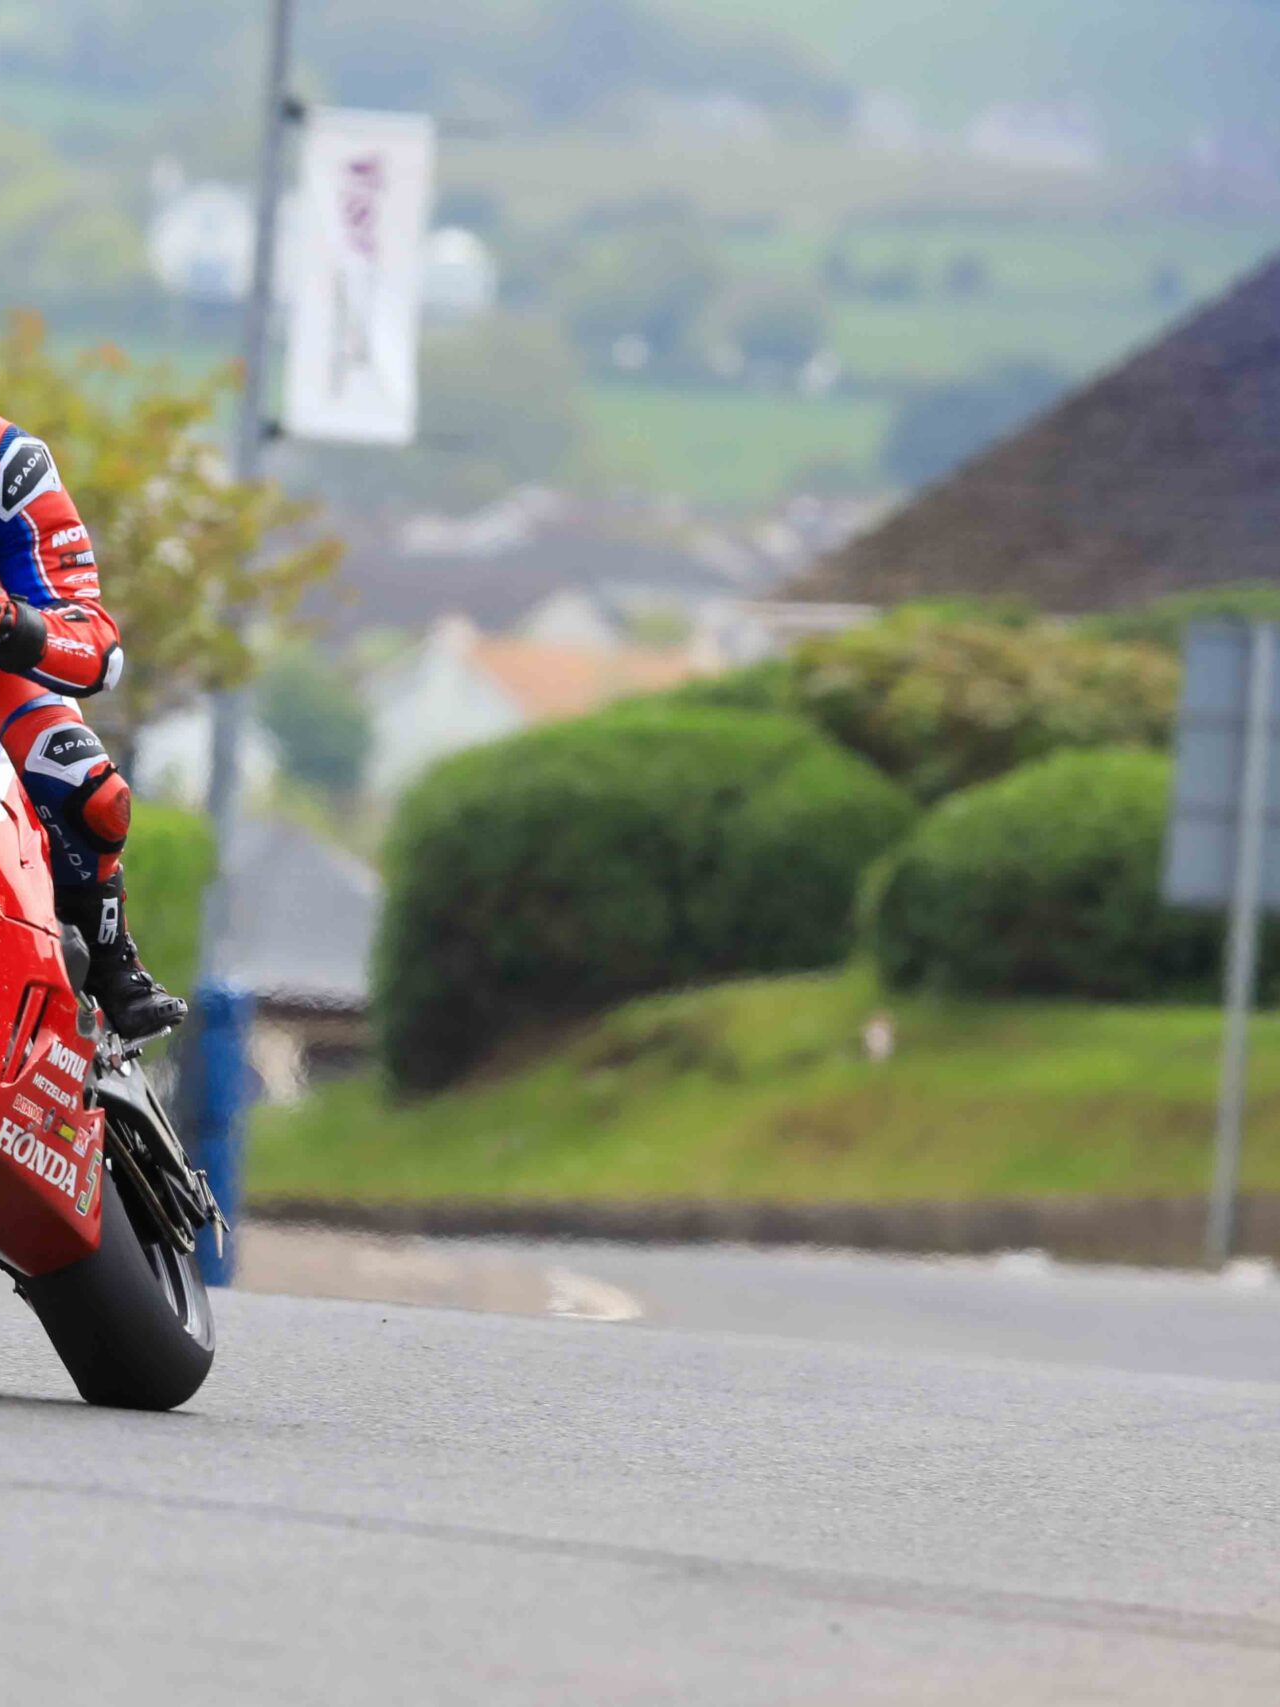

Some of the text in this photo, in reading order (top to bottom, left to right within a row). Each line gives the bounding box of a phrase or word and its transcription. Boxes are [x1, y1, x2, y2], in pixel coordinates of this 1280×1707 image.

[7, 452, 41, 496] SPADA
[52, 524, 89, 549] MOT
[53, 738, 101, 755] SPADA
[98, 897, 118, 944] SIDI
[47, 1041, 87, 1082] MOTUL
[32, 1072, 70, 1107] METZELER
[75, 1148, 103, 1216] 5
